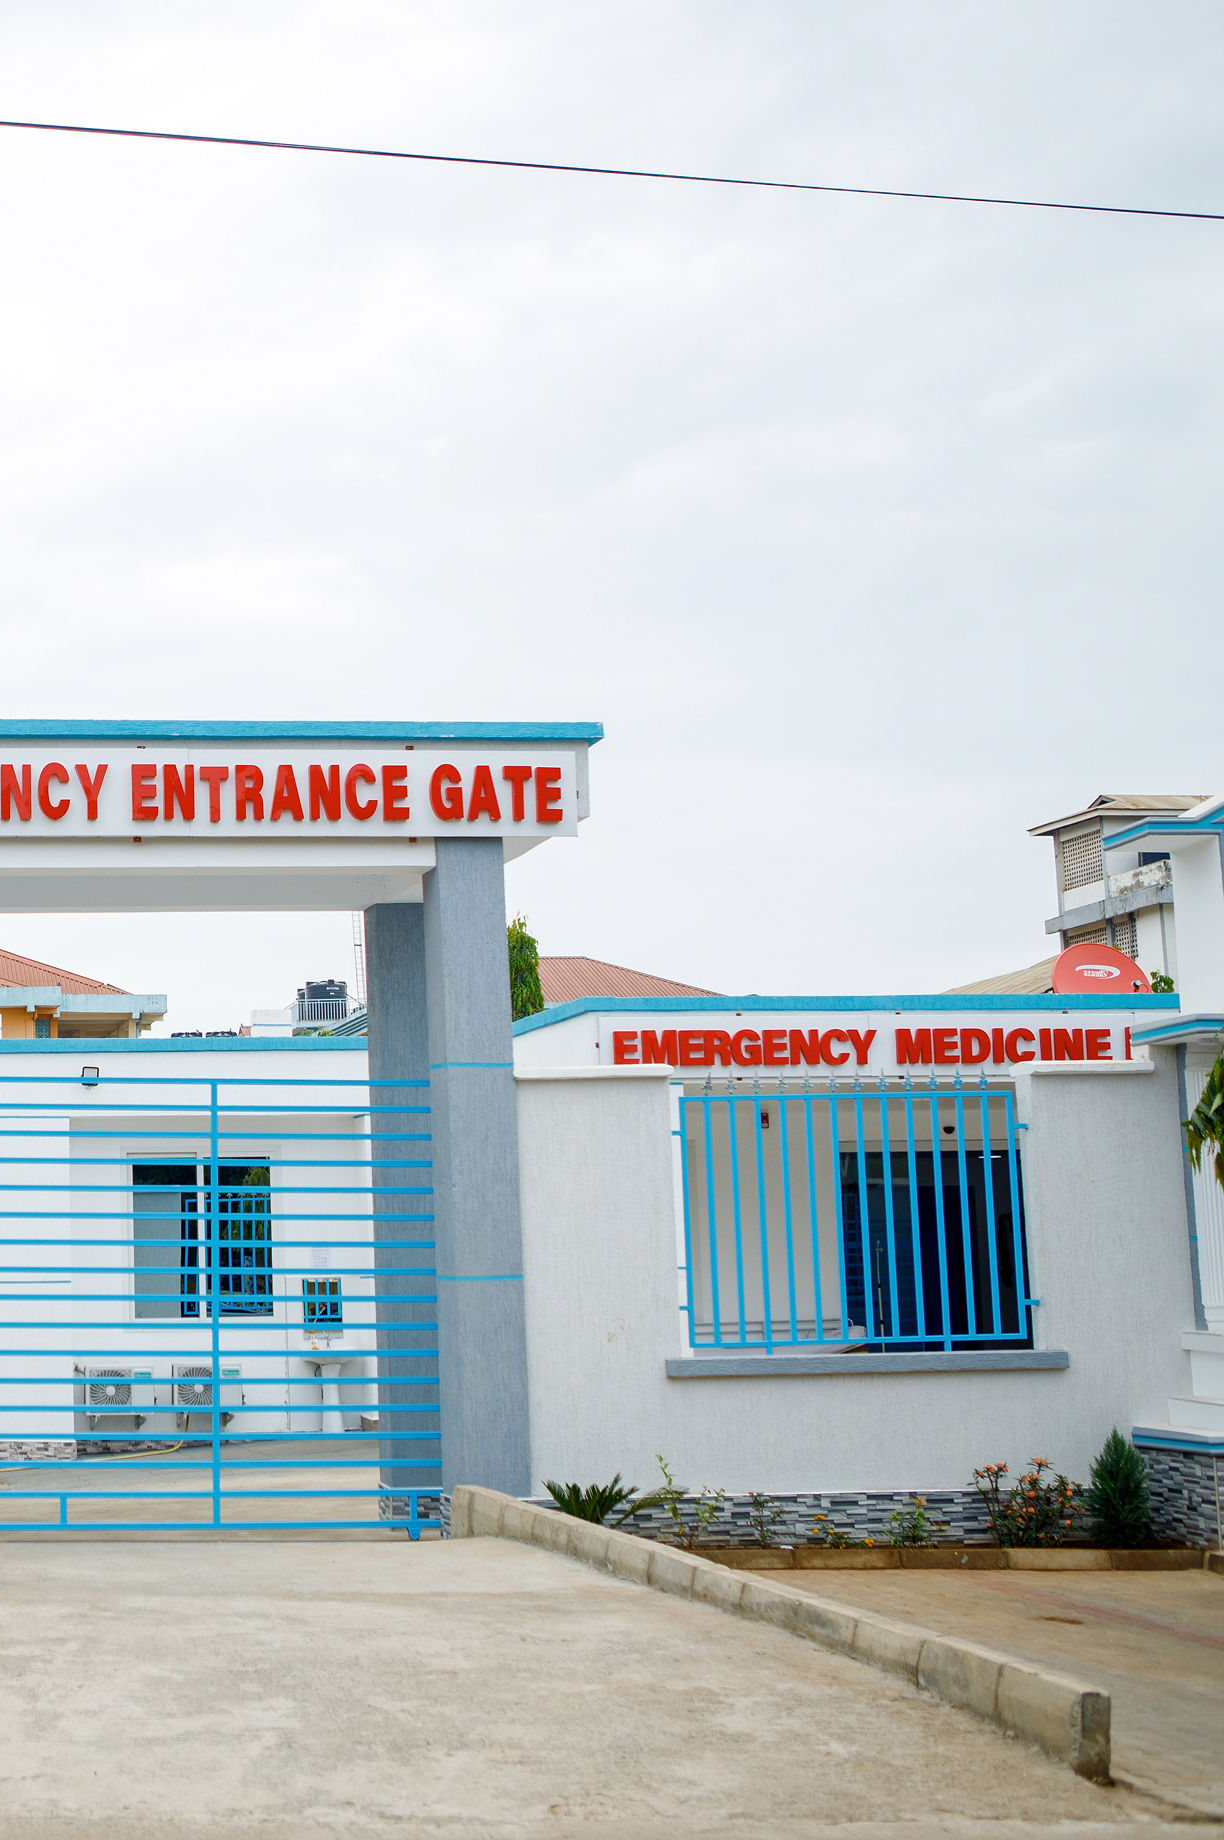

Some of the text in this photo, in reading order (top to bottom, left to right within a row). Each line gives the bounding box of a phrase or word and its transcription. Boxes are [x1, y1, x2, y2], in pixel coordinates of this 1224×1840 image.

[131, 763, 410, 822] ENTRANCE
[429, 763, 563, 823] GATE
[612, 1028, 877, 1067] EMERGENCY
[895, 1027, 1114, 1065] MEDICINE
